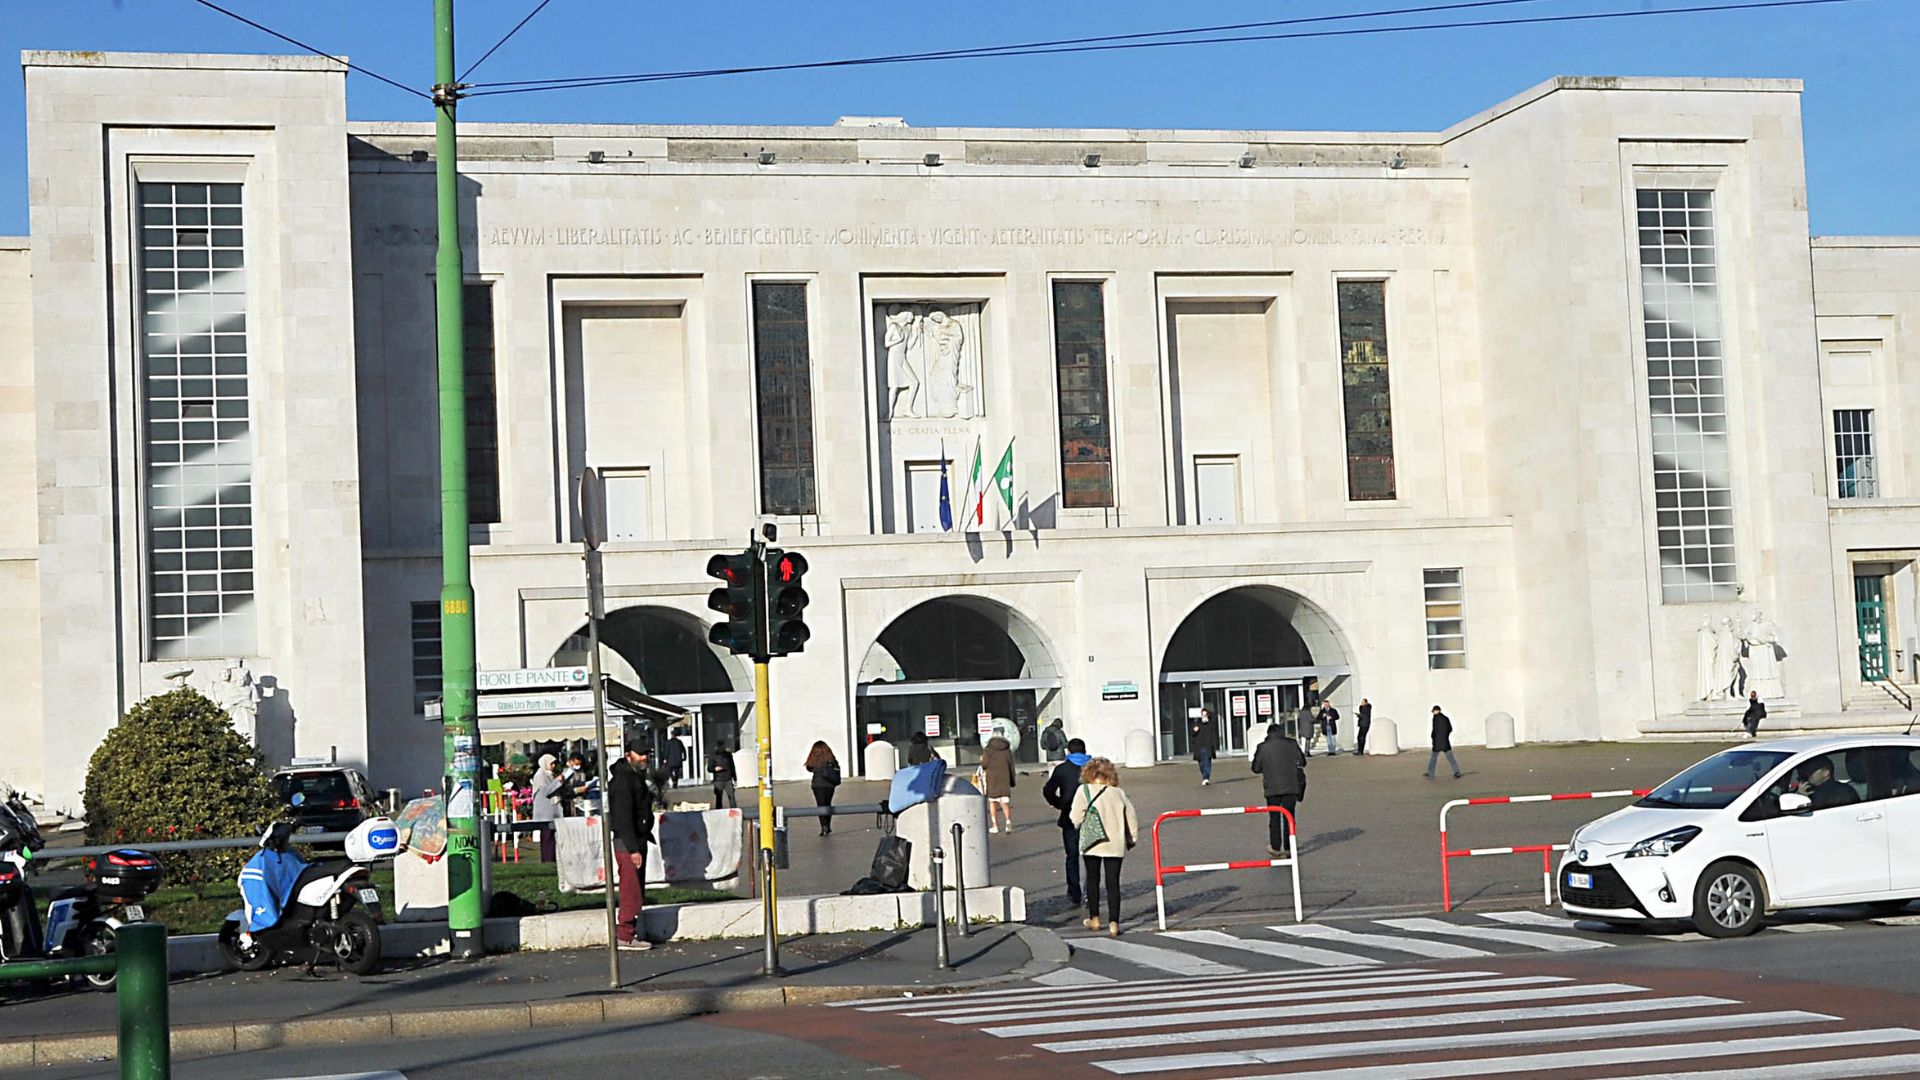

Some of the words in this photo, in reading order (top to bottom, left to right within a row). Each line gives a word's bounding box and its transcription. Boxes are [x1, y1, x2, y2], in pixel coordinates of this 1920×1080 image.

[491, 227, 545, 245] AEVVM
[556, 227, 662, 245] LIBERALITATIS
[672, 228, 694, 245] AC
[705, 227, 813, 245] BENEFICENTIAE
[824, 227, 919, 245] MONIMENTA
[931, 227, 980, 245] VIGENT
[991, 227, 1085, 245] AETERNITATIS
[908, 427, 939, 435] GRATIA
[479, 673, 511, 686] FIORI
[515, 672, 522, 684] E
[526, 670, 570, 684] PIANTE
